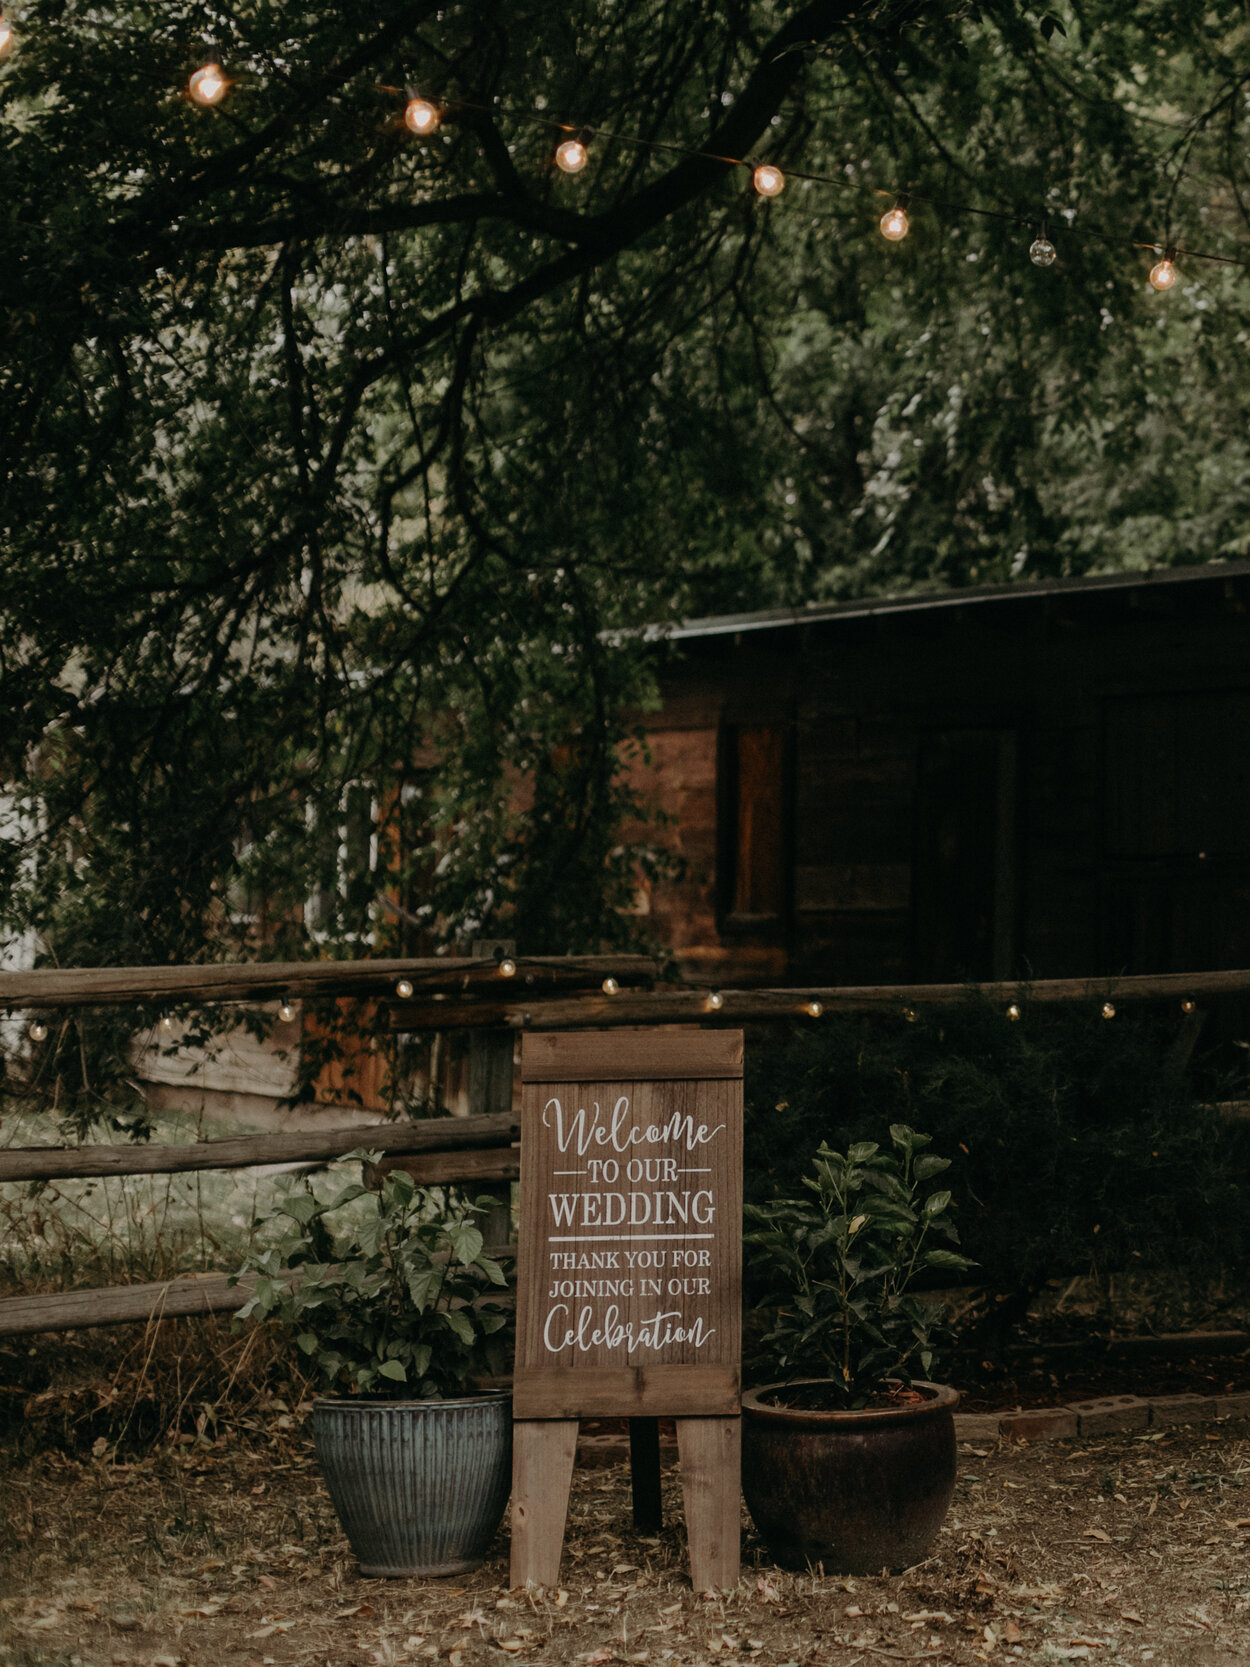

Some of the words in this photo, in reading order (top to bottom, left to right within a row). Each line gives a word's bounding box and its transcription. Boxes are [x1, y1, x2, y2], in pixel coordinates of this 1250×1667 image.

[542, 1096, 726, 1156] Welcome
[587, 1159, 619, 1183] TO
[627, 1158, 678, 1183] OUR
[548, 1190, 716, 1227] WEDDING
[550, 1251, 620, 1270] THANK
[624, 1250, 667, 1268] YOU
[672, 1249, 711, 1267] FOR
[548, 1279, 634, 1298] JOINING
[639, 1279, 661, 1296] IN
[667, 1278, 711, 1296] OUR
[543, 1304, 716, 1353] Celebration
